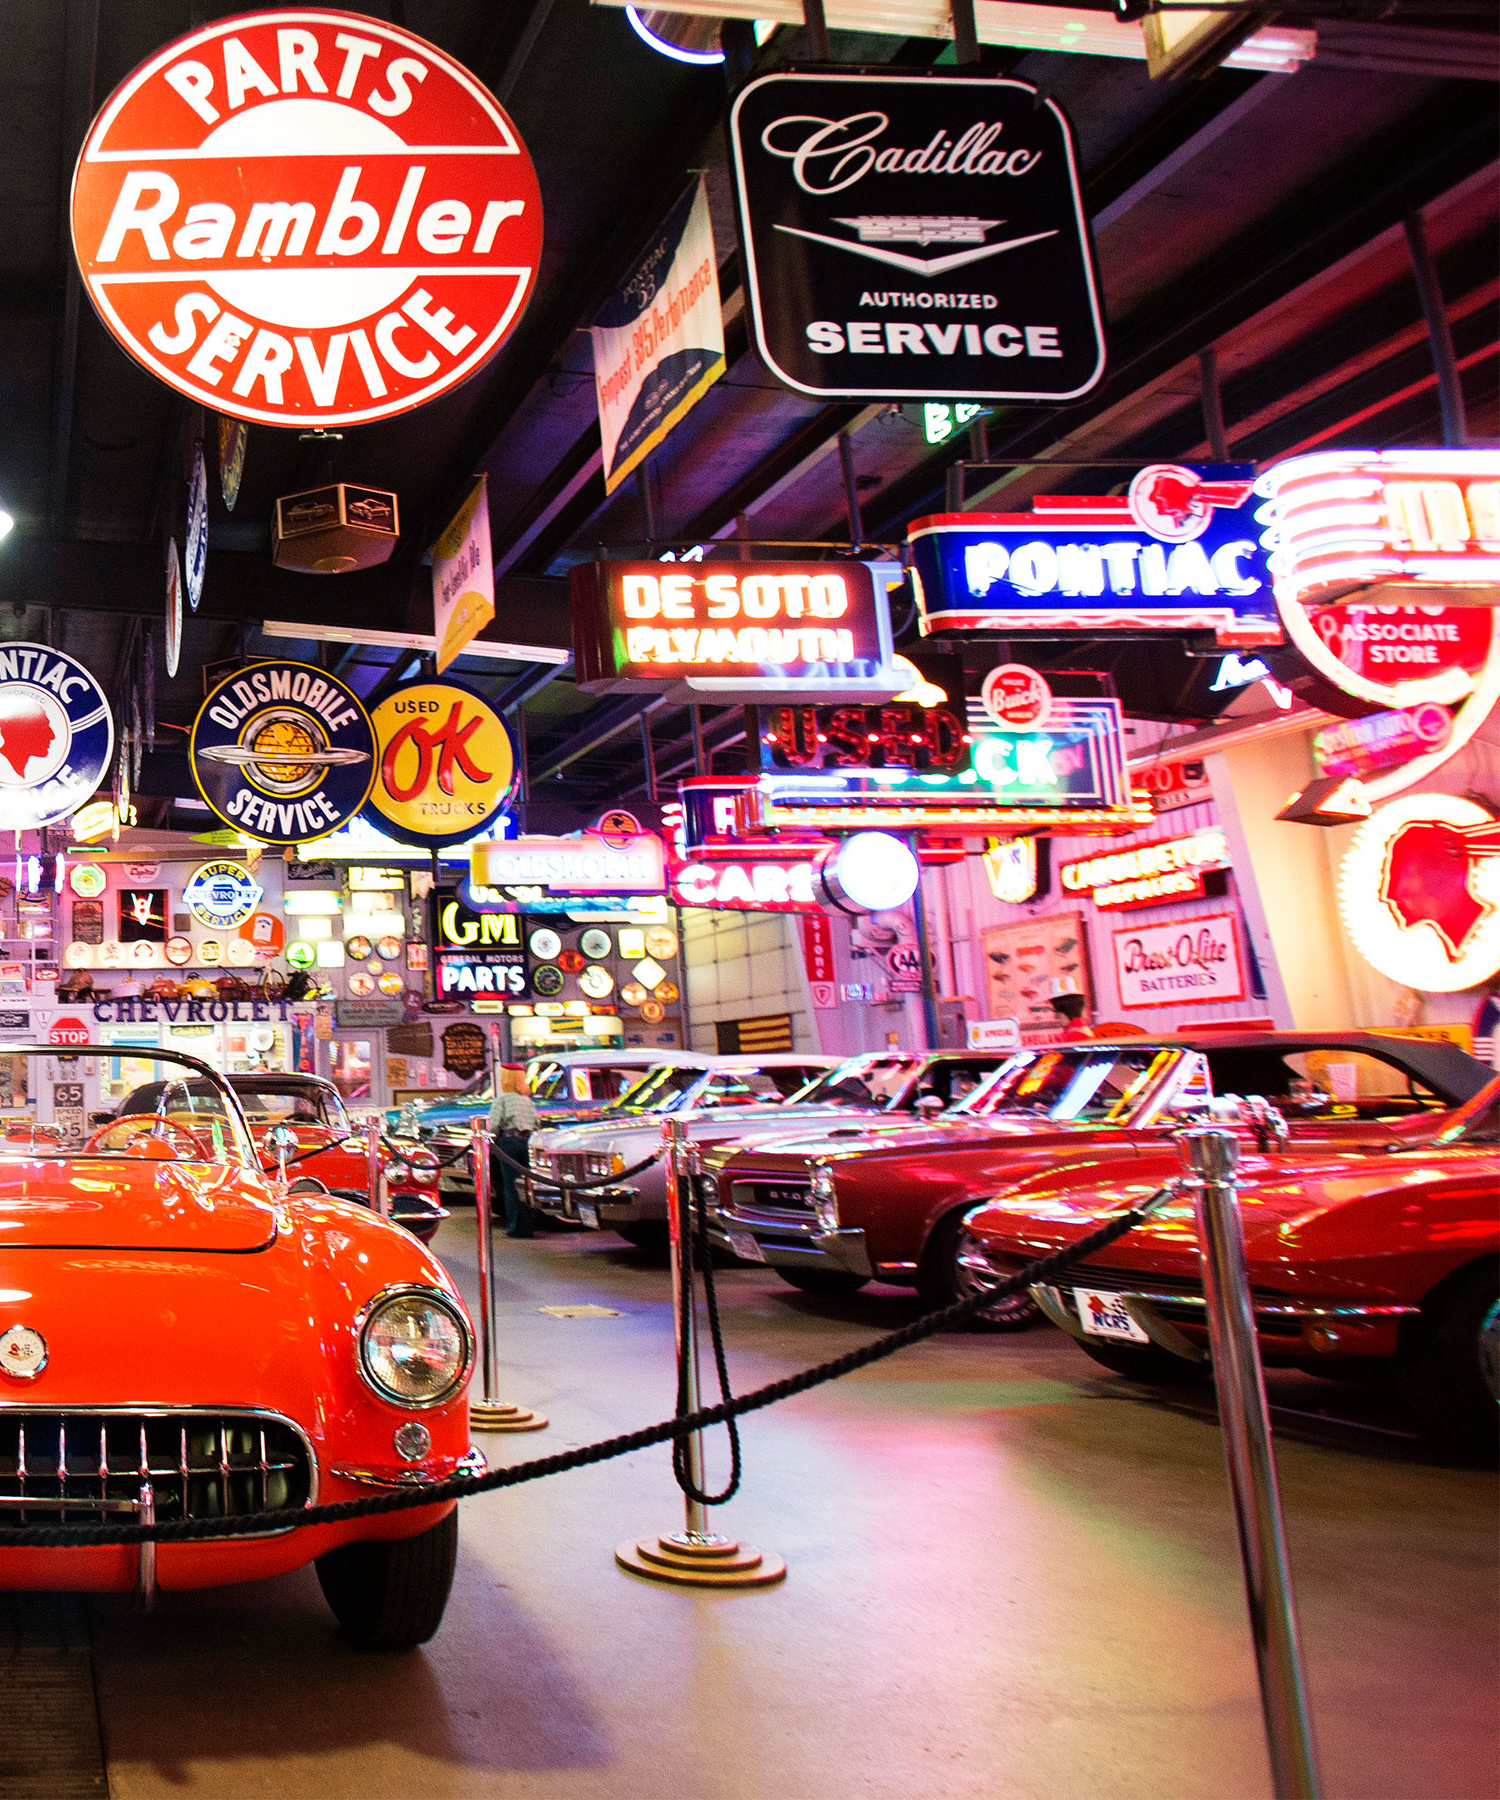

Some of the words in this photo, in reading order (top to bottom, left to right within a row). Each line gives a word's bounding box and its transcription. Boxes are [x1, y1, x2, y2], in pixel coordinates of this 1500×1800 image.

[164, 28, 428, 126] PARTS
[762, 111, 1042, 194] Cadillac
[95, 165, 525, 263] Rambler
[858, 291, 998, 309] AUTHORIZED
[148, 288, 477, 407] SERVICE
[806, 321, 1063, 358] SERVICE
[965, 541, 1263, 597] PONTIAC
[621, 574, 696, 620] DE
[705, 574, 849, 620] SOTO
[626, 627, 855, 664] PLYMOUTH
[1341, 623, 1461, 642] ASSOCIATE
[1369, 645, 1440, 663] STORE
[209, 670, 358, 732] OLDSMOBILE
[395, 701, 440, 714] USED
[992, 679, 1042, 713] Buick
[780, 707, 964, 767] USED
[381, 700, 493, 802] OK
[227, 789, 342, 836] SERVICE
[420, 802, 486, 816] TRUCKS
[199, 866, 246, 881] SUPER
[188, 890, 258, 901] CHEVROLET
[196, 905, 249, 926] SERVICE
[442, 902, 520, 945] GM
[440, 954, 482, 964] GENERAL
[486, 954, 525, 964] MOTORS
[442, 966, 526, 992] PARTS
[1140, 972, 1218, 992] BATTERIES
[93, 999, 294, 1023] CHEVROLET
[50, 1031, 88, 1043] STOP
[55, 1086, 82, 1099] 65
[1093, 1312, 1130, 1332] NCRS
